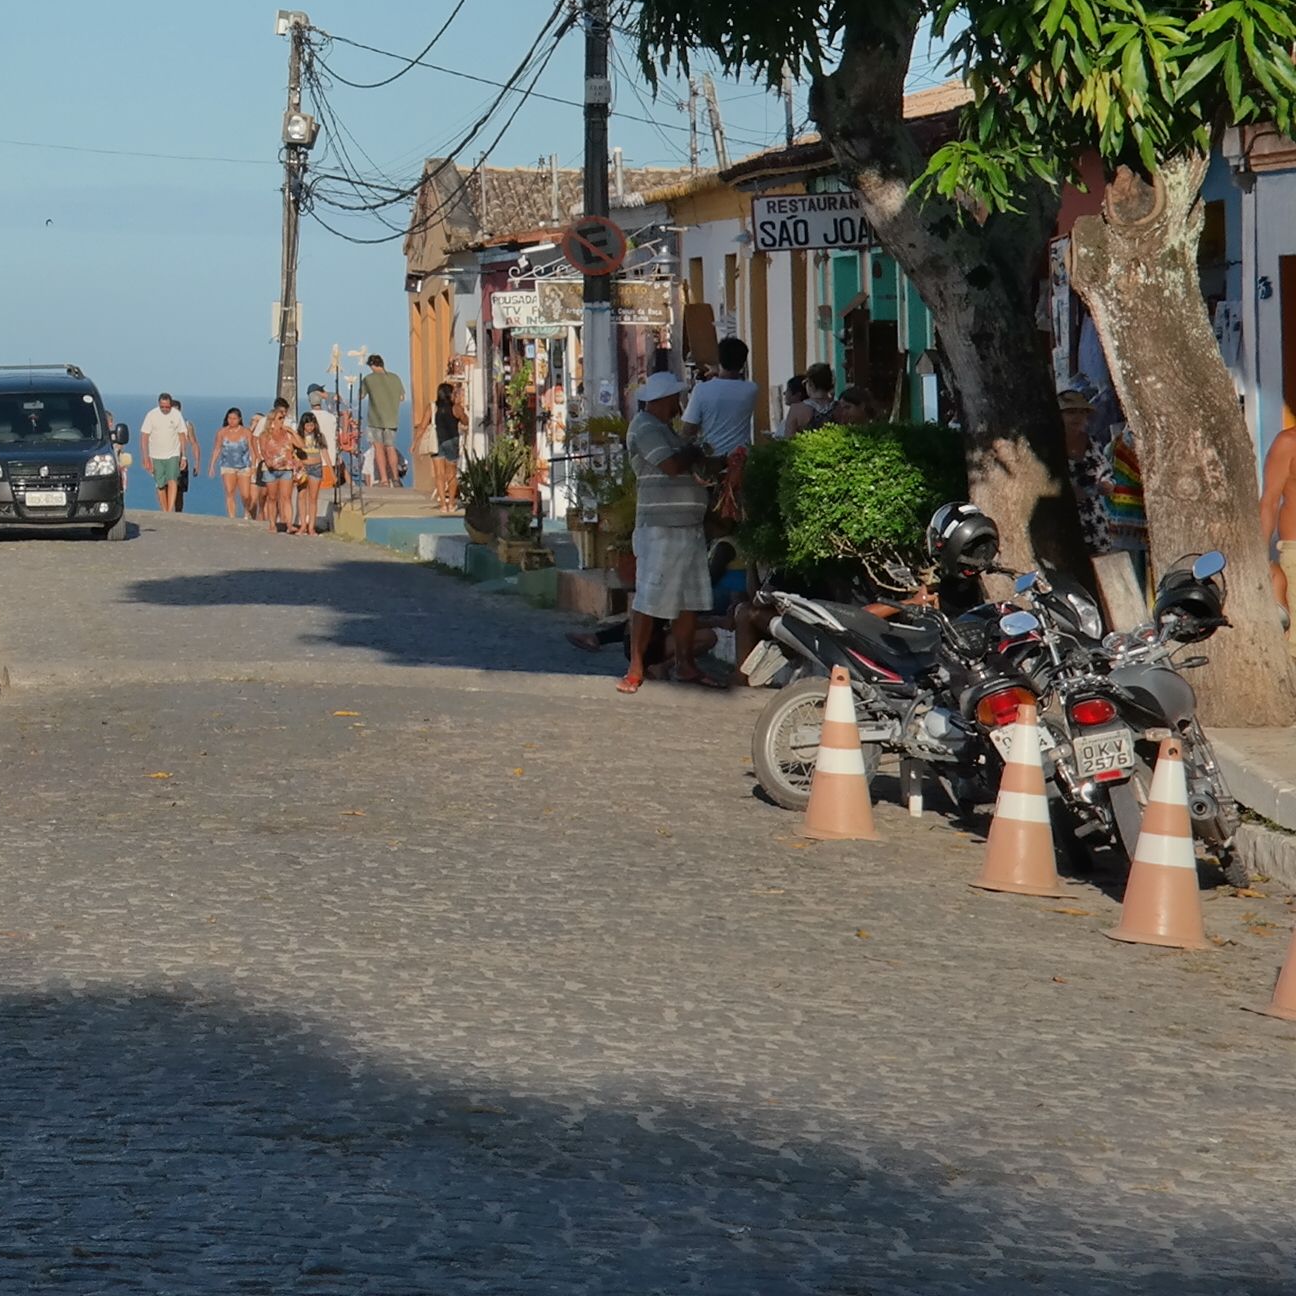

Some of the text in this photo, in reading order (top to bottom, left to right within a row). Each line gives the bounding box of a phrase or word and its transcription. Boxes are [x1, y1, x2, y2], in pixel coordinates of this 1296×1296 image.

[766, 194, 860, 214] RESTAURAN
[759, 214, 810, 248] SÃO
[503, 306, 521, 315] TV
[1084, 753, 1128, 773] 2576
